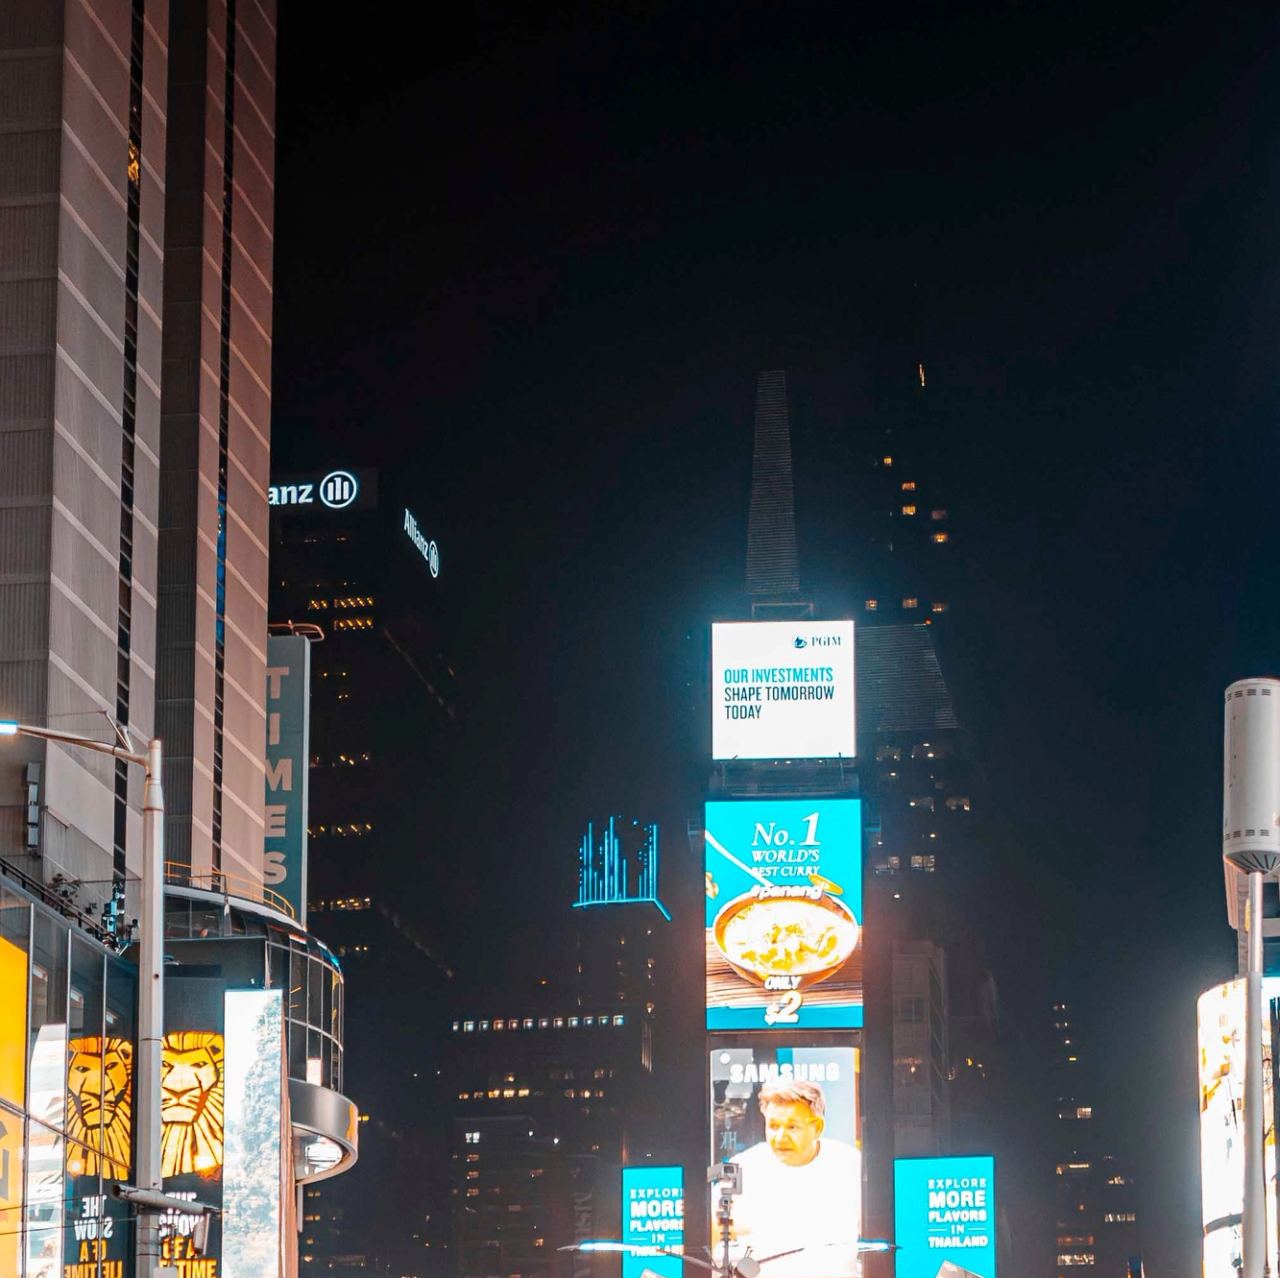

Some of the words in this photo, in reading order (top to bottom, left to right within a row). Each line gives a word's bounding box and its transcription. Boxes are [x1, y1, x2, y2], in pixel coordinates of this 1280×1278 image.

[404, 508, 428, 561] Allianz
[812, 636, 841, 647] PGIM
[724, 668, 749, 684] OUR
[752, 667, 833, 683] INVESTMENTS
[724, 686, 762, 701] SHAPE
[766, 686, 834, 701] TOMORROW
[725, 705, 762, 720] TODAY
[751, 850, 820, 863] WORLD'S
[730, 1063, 840, 1083] SAMSUNG
[928, 1179, 987, 1189] EXPLORE
[928, 1191, 986, 1208] MORE
[630, 1201, 684, 1218] MORE
[928, 1210, 987, 1222] FLAVORS
[951, 1225, 964, 1233] IN
[652, 1234, 665, 1242] IN
[928, 1237, 988, 1248] THAILAND
